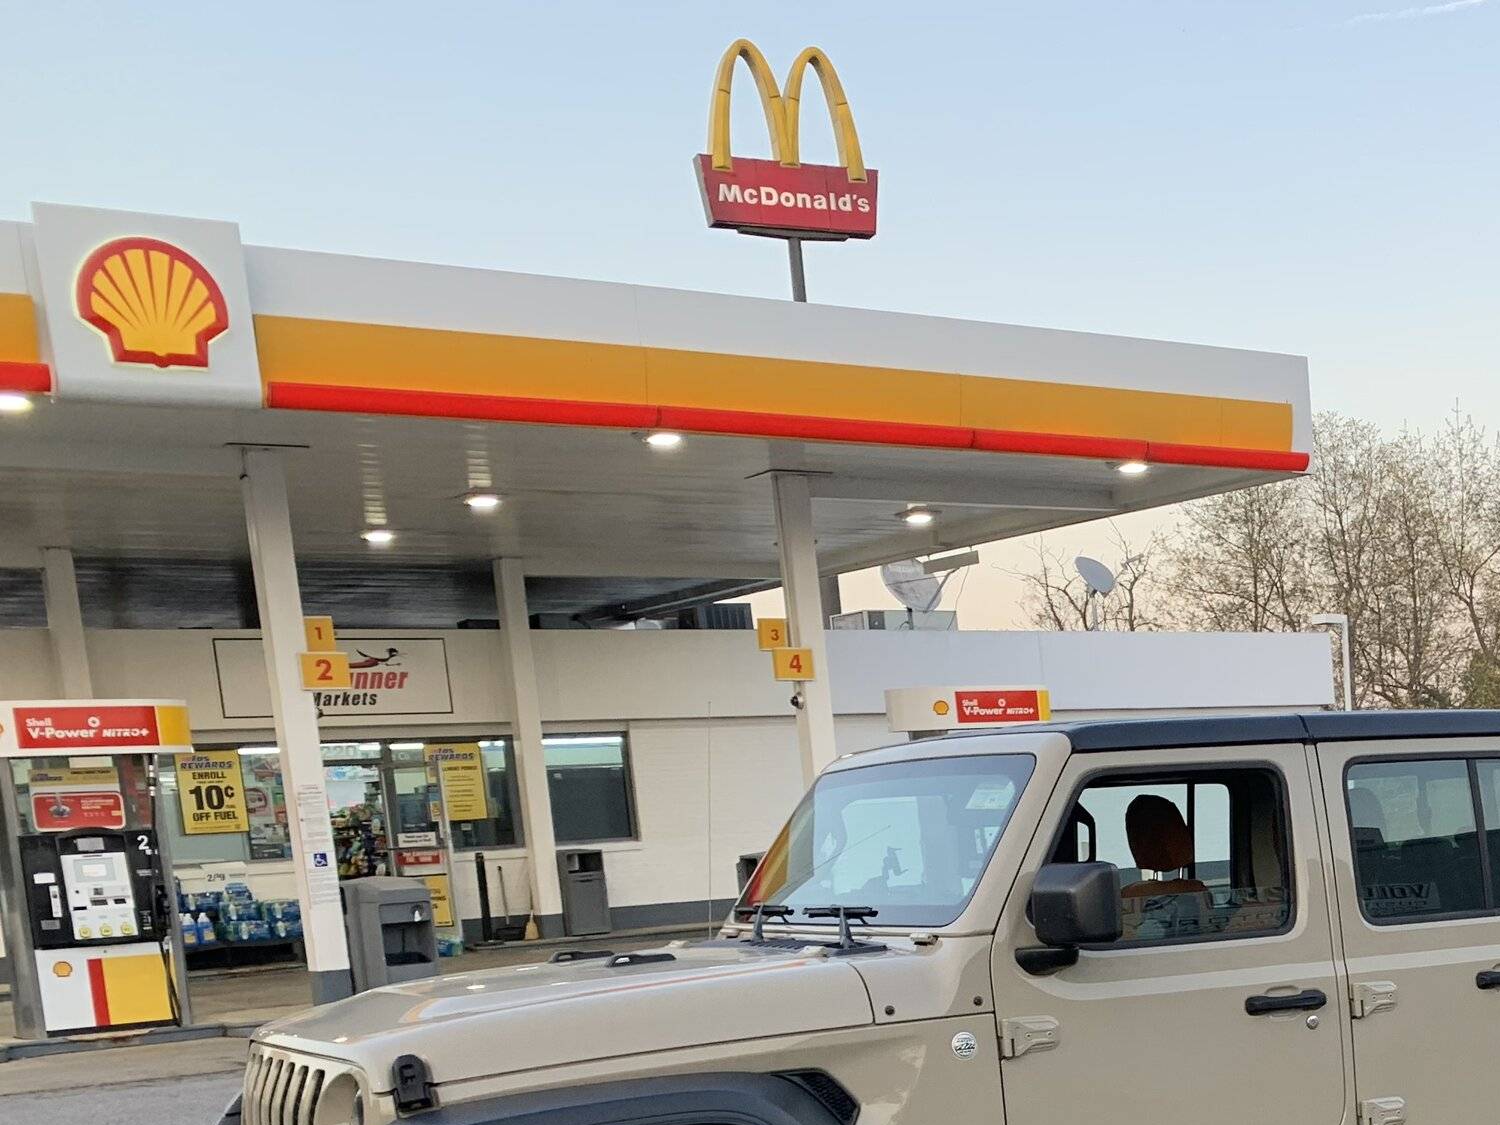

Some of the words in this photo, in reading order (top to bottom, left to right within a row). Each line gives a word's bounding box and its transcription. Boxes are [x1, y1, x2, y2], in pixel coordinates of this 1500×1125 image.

[718, 183, 870, 212] McDonald's
[314, 626, 323, 641] 1
[770, 629, 780, 641] 3
[789, 654, 802, 673] 4
[315, 659, 334, 681] 2
[963, 706, 1005, 716] V-Power
[25, 718, 52, 727] Shell
[27, 727, 98, 739] V-Power
[102, 728, 150, 738] NITRO+
[180, 761, 233, 769] REWARDS
[192, 771, 227, 780] ENROLL
[192, 812, 212, 822] OFF
[214, 811, 238, 820] FUEL
[137, 835, 150, 850] 2
